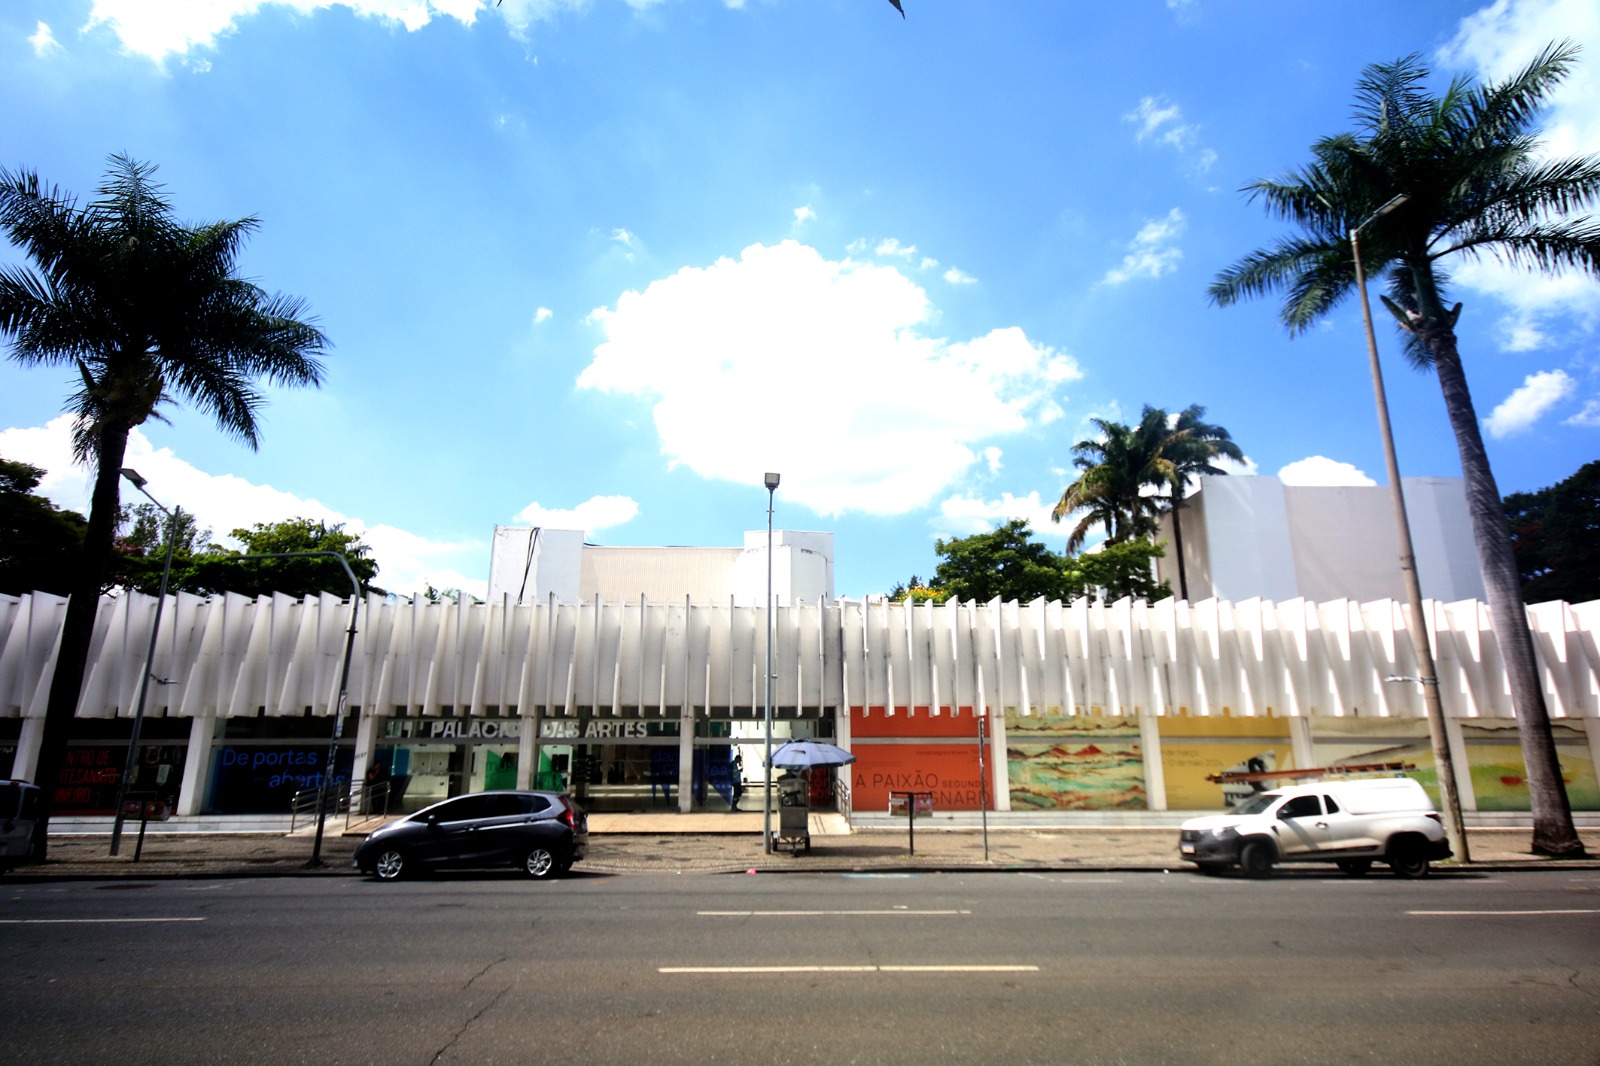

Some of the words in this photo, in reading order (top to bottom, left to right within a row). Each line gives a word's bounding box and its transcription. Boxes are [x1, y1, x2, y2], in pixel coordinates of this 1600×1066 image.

[540, 721, 580, 739] DAS
[584, 721, 648, 739] ARTES
[96, 750, 112, 766] DE
[223, 749, 249, 766] De
[252, 749, 318, 770] portas
[855, 773, 866, 788] A
[873, 770, 939, 789] PAIXÃO
[942, 779, 989, 788] SEGUNDO
